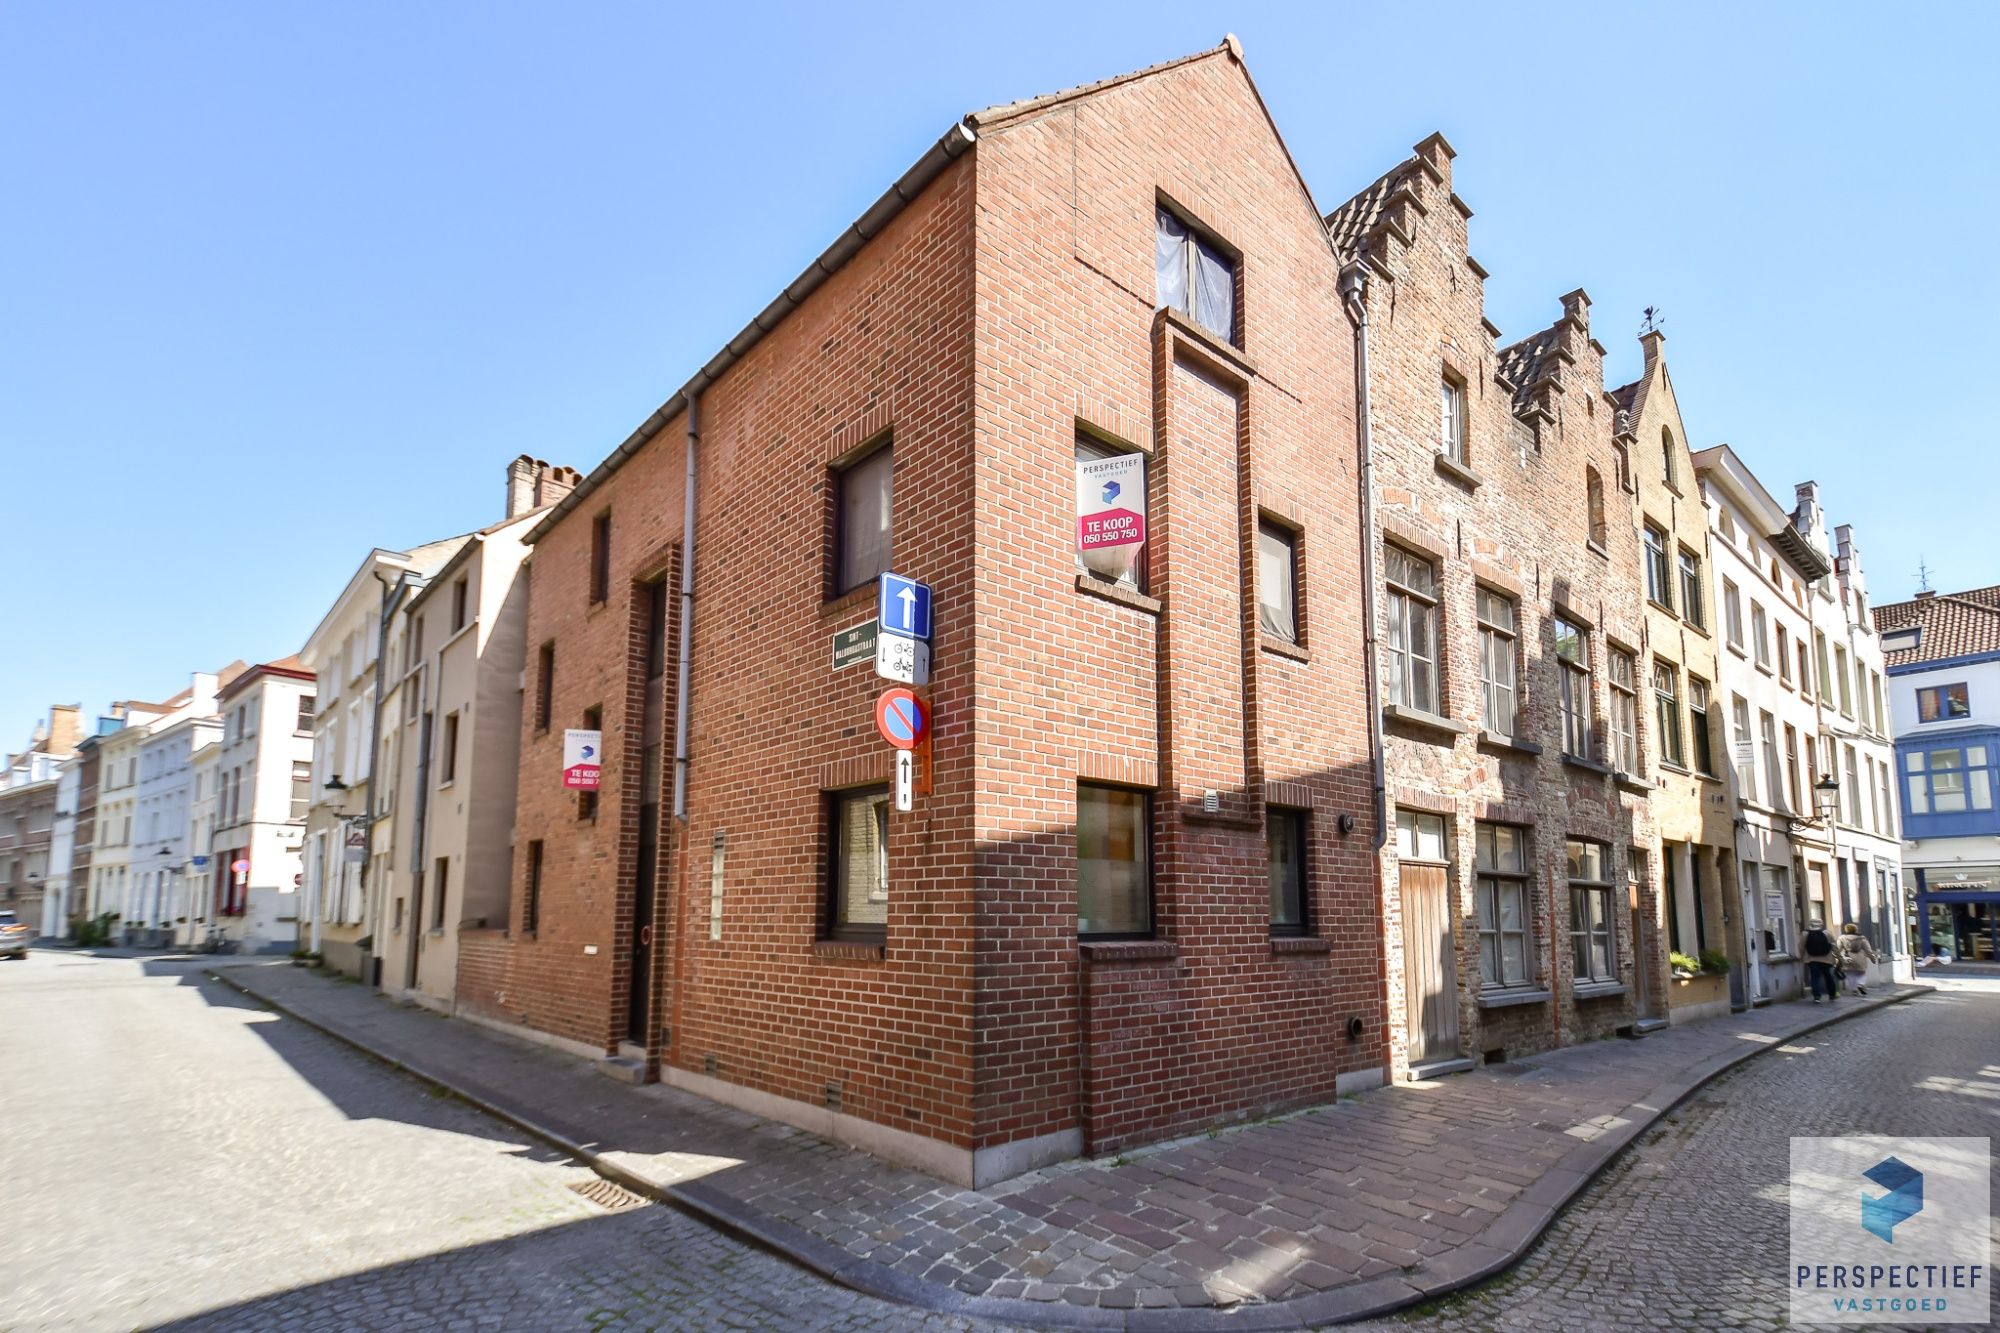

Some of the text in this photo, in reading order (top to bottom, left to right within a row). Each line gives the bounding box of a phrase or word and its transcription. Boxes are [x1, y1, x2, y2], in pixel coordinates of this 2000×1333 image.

[1083, 458, 1139, 474] PERSPECTIEF
[1087, 516, 1133, 533] TE KOOP
[1083, 528, 1138, 544] 050 550 750
[571, 769, 600, 778] TE KOO
